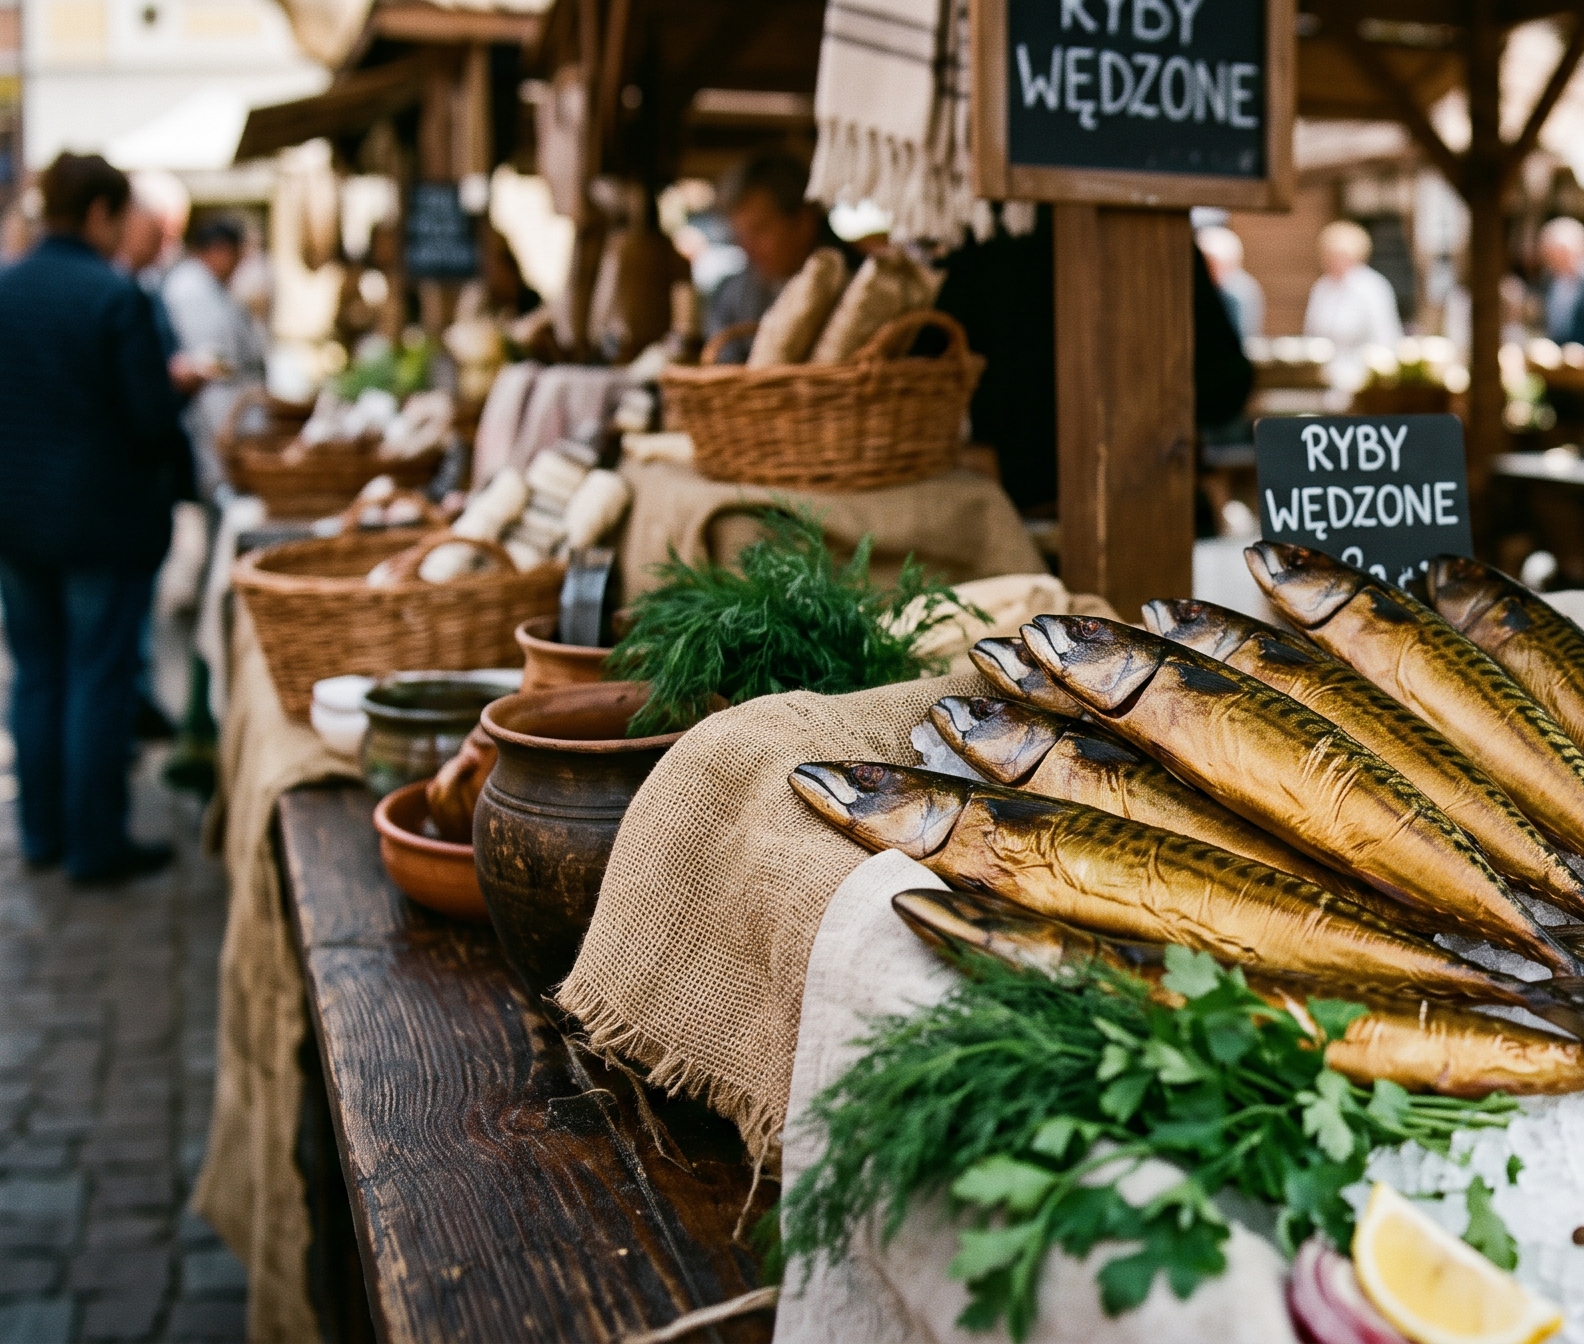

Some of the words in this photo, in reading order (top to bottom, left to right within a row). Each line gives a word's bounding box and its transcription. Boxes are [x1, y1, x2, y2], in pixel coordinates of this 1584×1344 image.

[1016, 43, 1260, 131] WĘDZONE
[1301, 424, 1408, 472] RYBY
[1265, 482, 1459, 541] WĘDZONE
